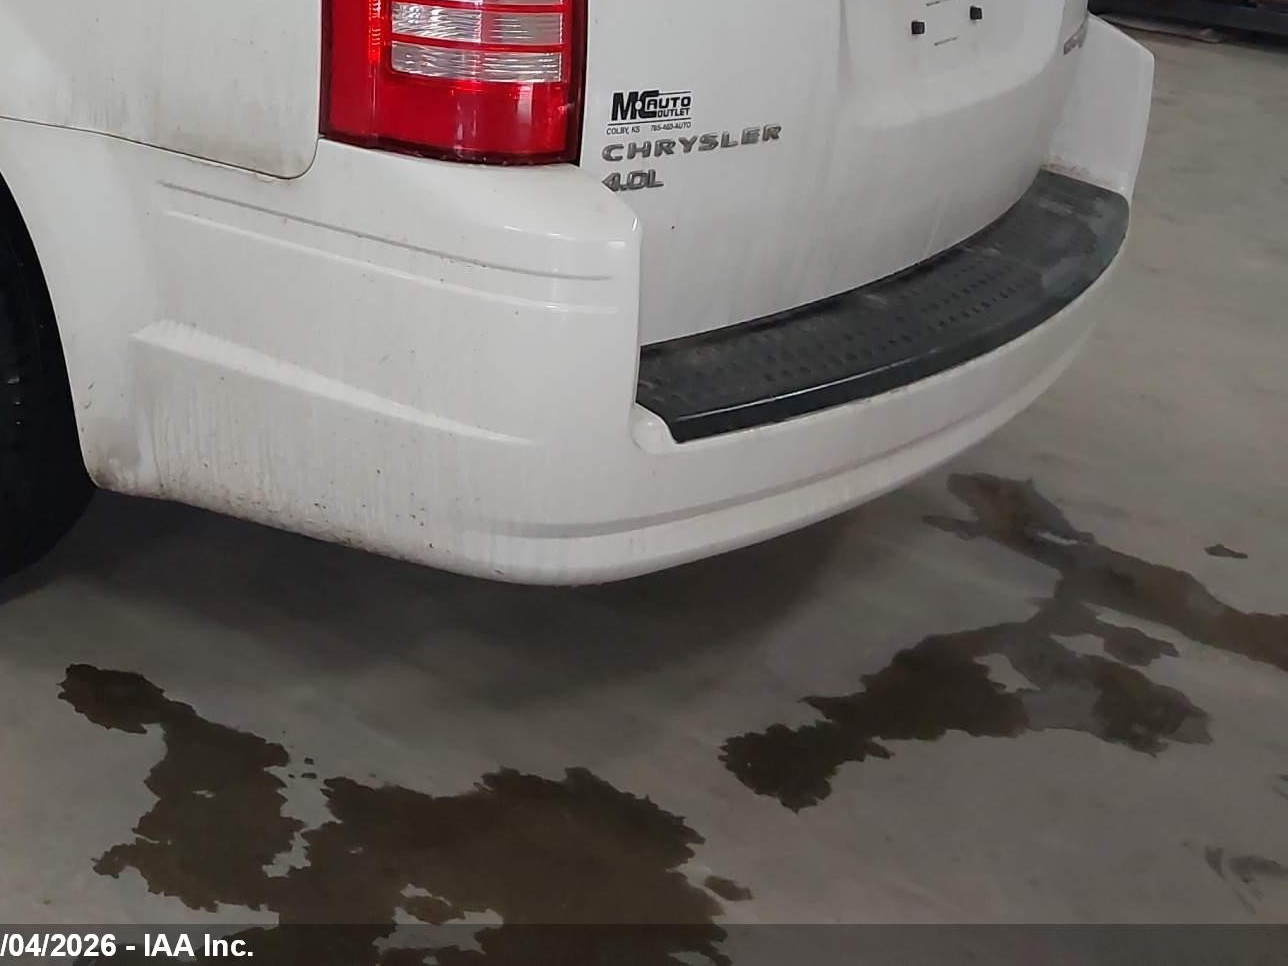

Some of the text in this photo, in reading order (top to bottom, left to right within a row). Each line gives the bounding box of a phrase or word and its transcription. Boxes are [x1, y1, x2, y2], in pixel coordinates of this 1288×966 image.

[647, 95, 692, 110] AUTO
[657, 107, 691, 119] OUTLET
[601, 124, 783, 162] CHRYSLER
[602, 169, 664, 192] 4.0L
